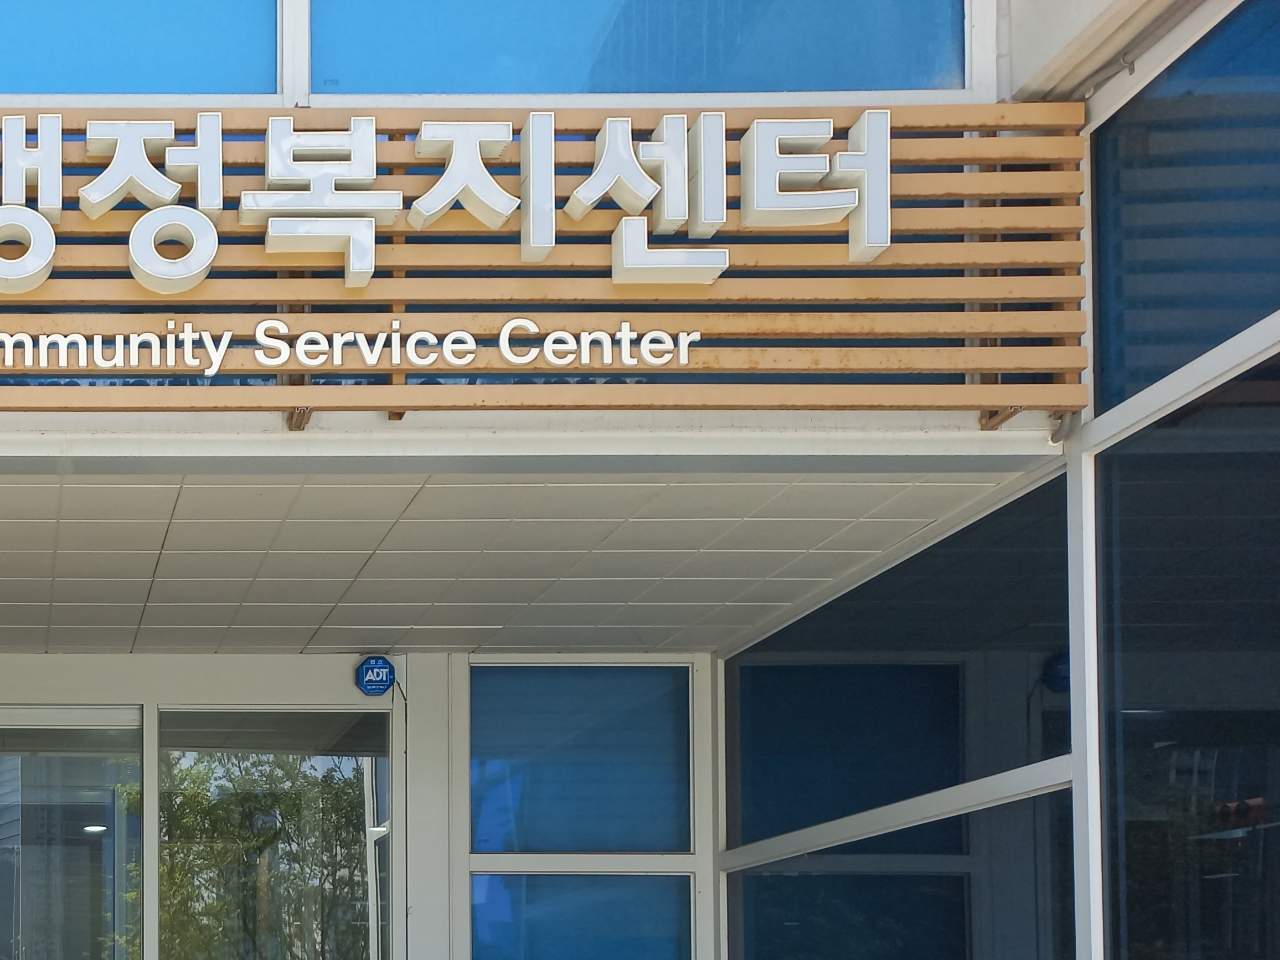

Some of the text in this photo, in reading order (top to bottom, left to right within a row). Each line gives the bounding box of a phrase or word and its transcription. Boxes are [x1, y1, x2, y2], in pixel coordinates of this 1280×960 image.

[253, 319, 477, 369] Service
[497, 317, 702, 368] Center
[365, 668, 389, 681] ADT
